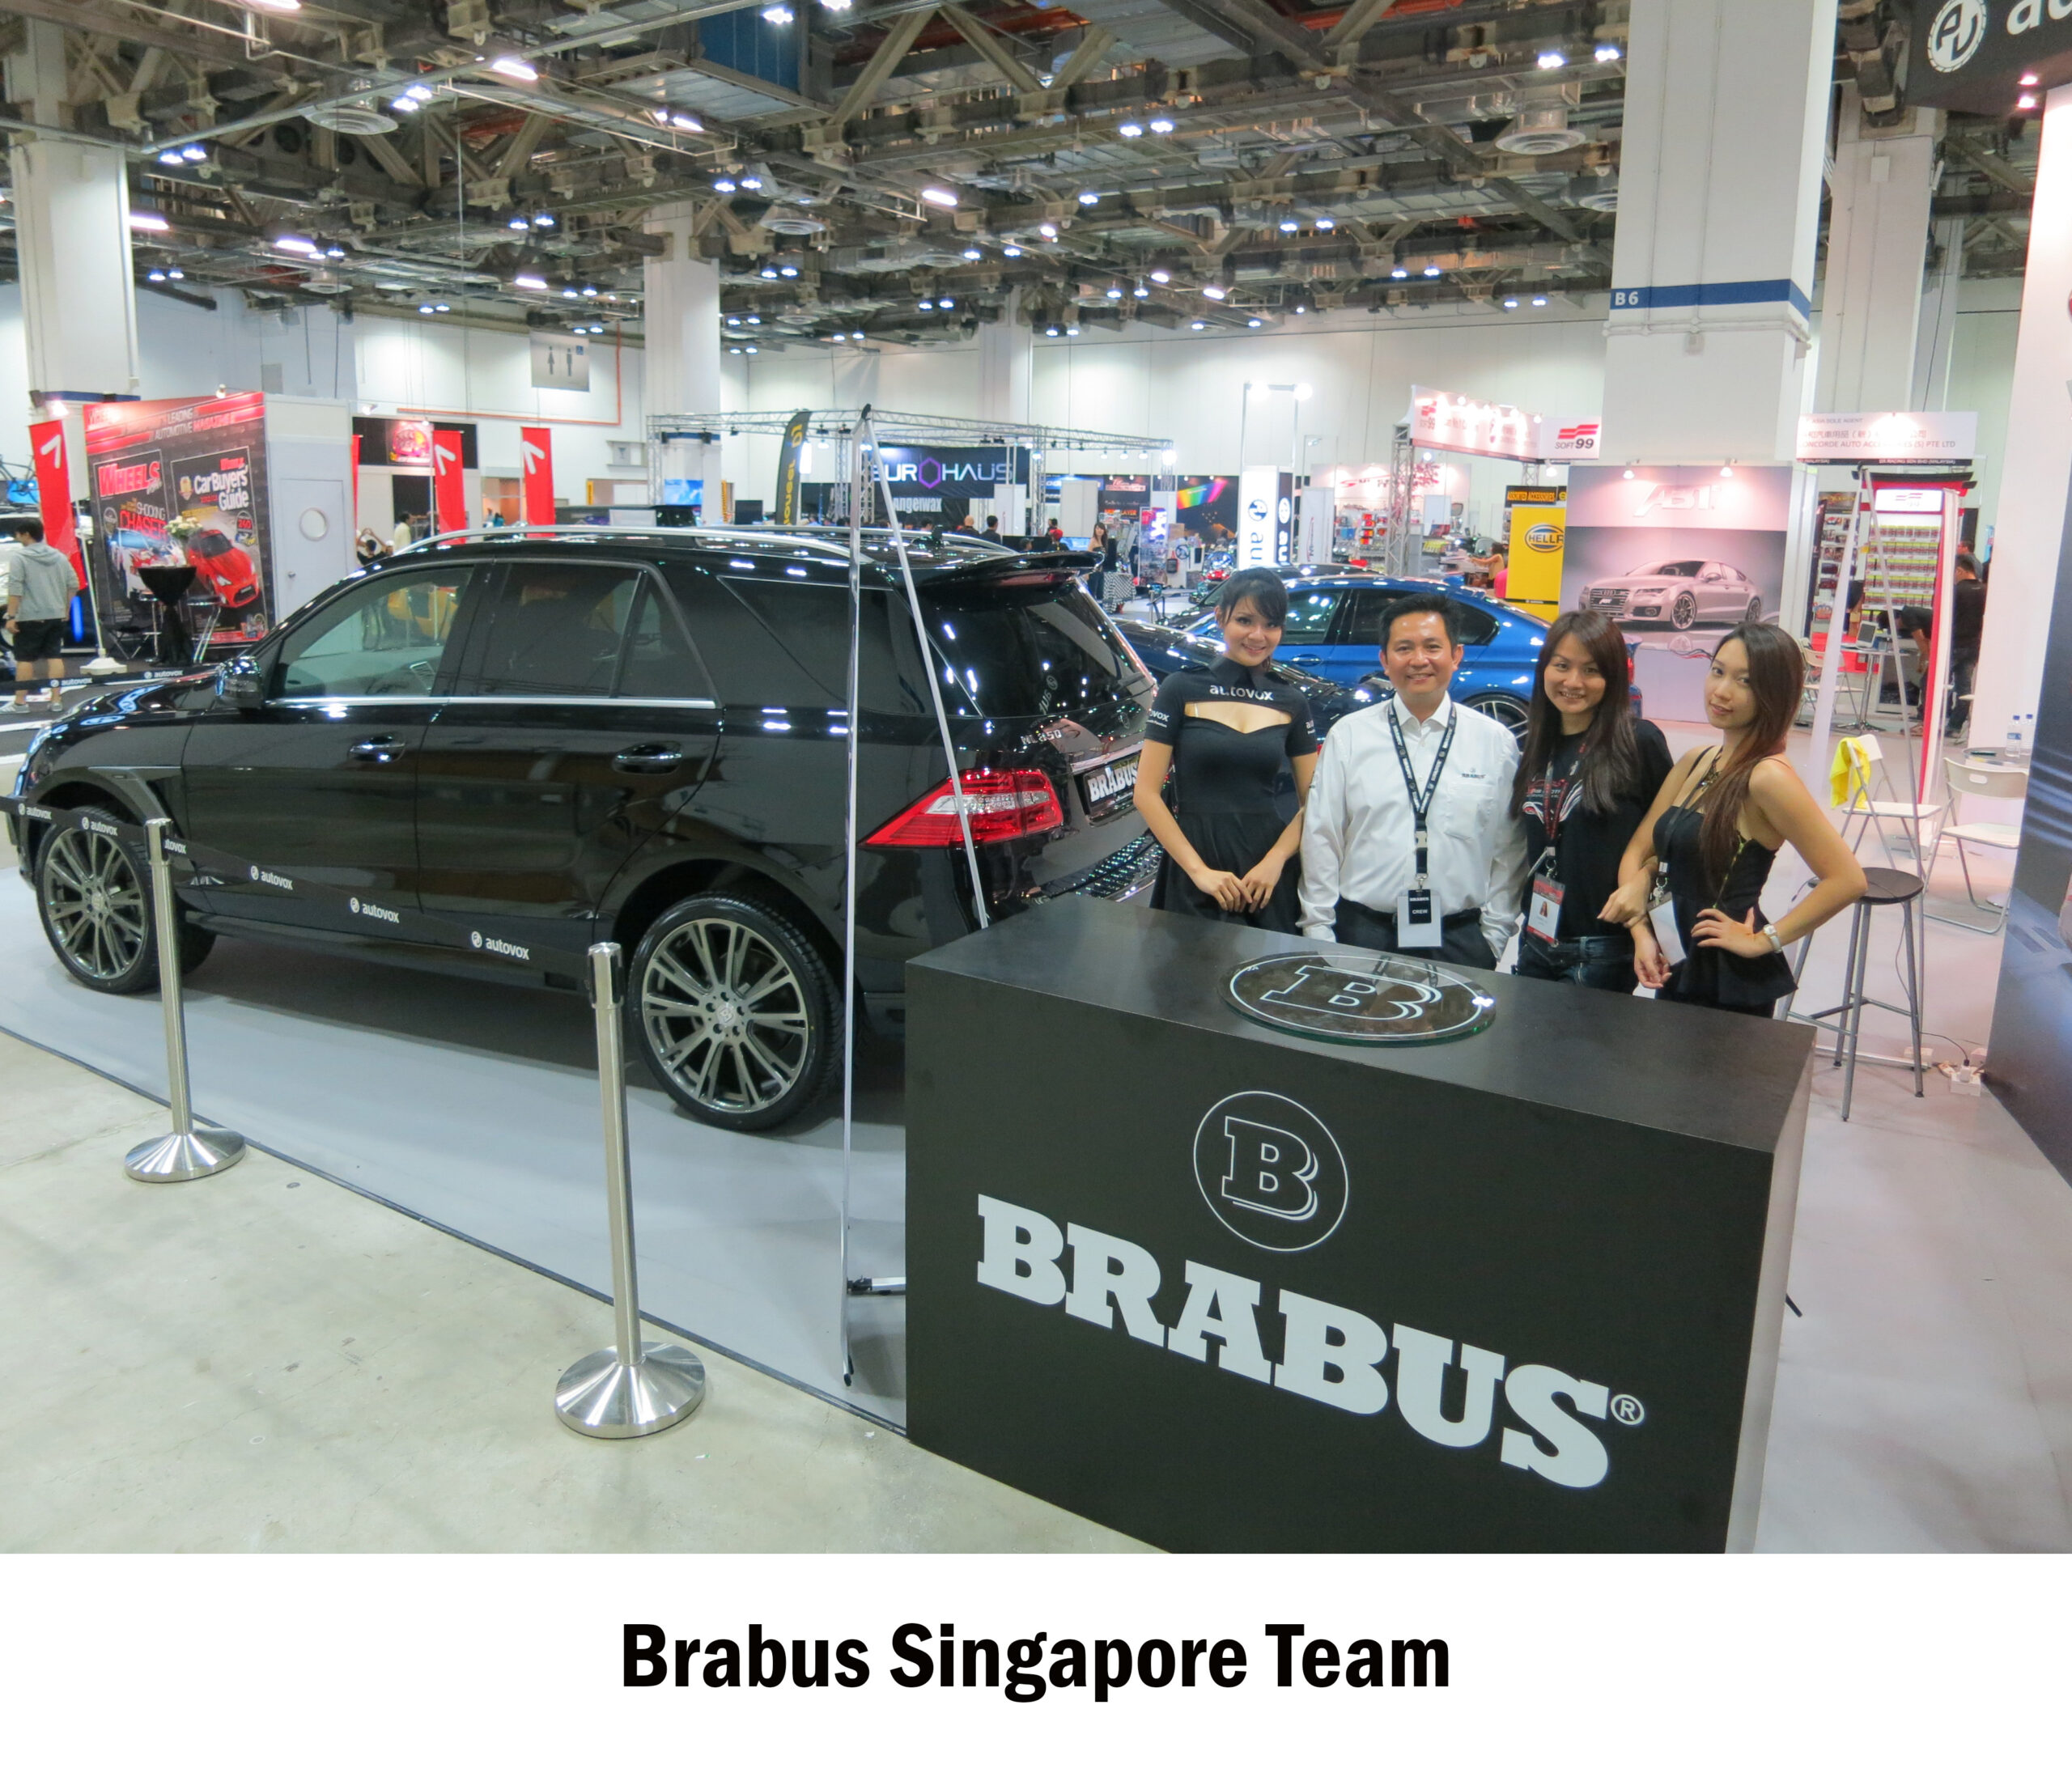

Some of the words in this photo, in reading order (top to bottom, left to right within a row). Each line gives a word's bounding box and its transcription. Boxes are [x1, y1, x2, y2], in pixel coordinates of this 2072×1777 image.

[1614, 290, 1639, 307] B6
[167, 407, 193, 425] LEADING
[155, 421, 193, 440] AUTOMOTIVE
[1799, 440, 1838, 448] ONCORDE
[1840, 440, 1862, 448] AUTO
[1926, 440, 1939, 448] PTE
[1942, 440, 1956, 448] LTD
[98, 460, 161, 497] WHEELS
[218, 488, 249, 511] Guide
[893, 497, 943, 514] Angelwax
[61, 678, 92, 686] autovox
[26, 807, 53, 820] autovox
[91, 821, 118, 836] autovox
[261, 870, 294, 890] autovox
[362, 901, 400, 924] autovox
[485, 936, 530, 961] autovox
[1221, 1115, 1318, 1221] B
[977, 1193, 1611, 1489] BRABUS
